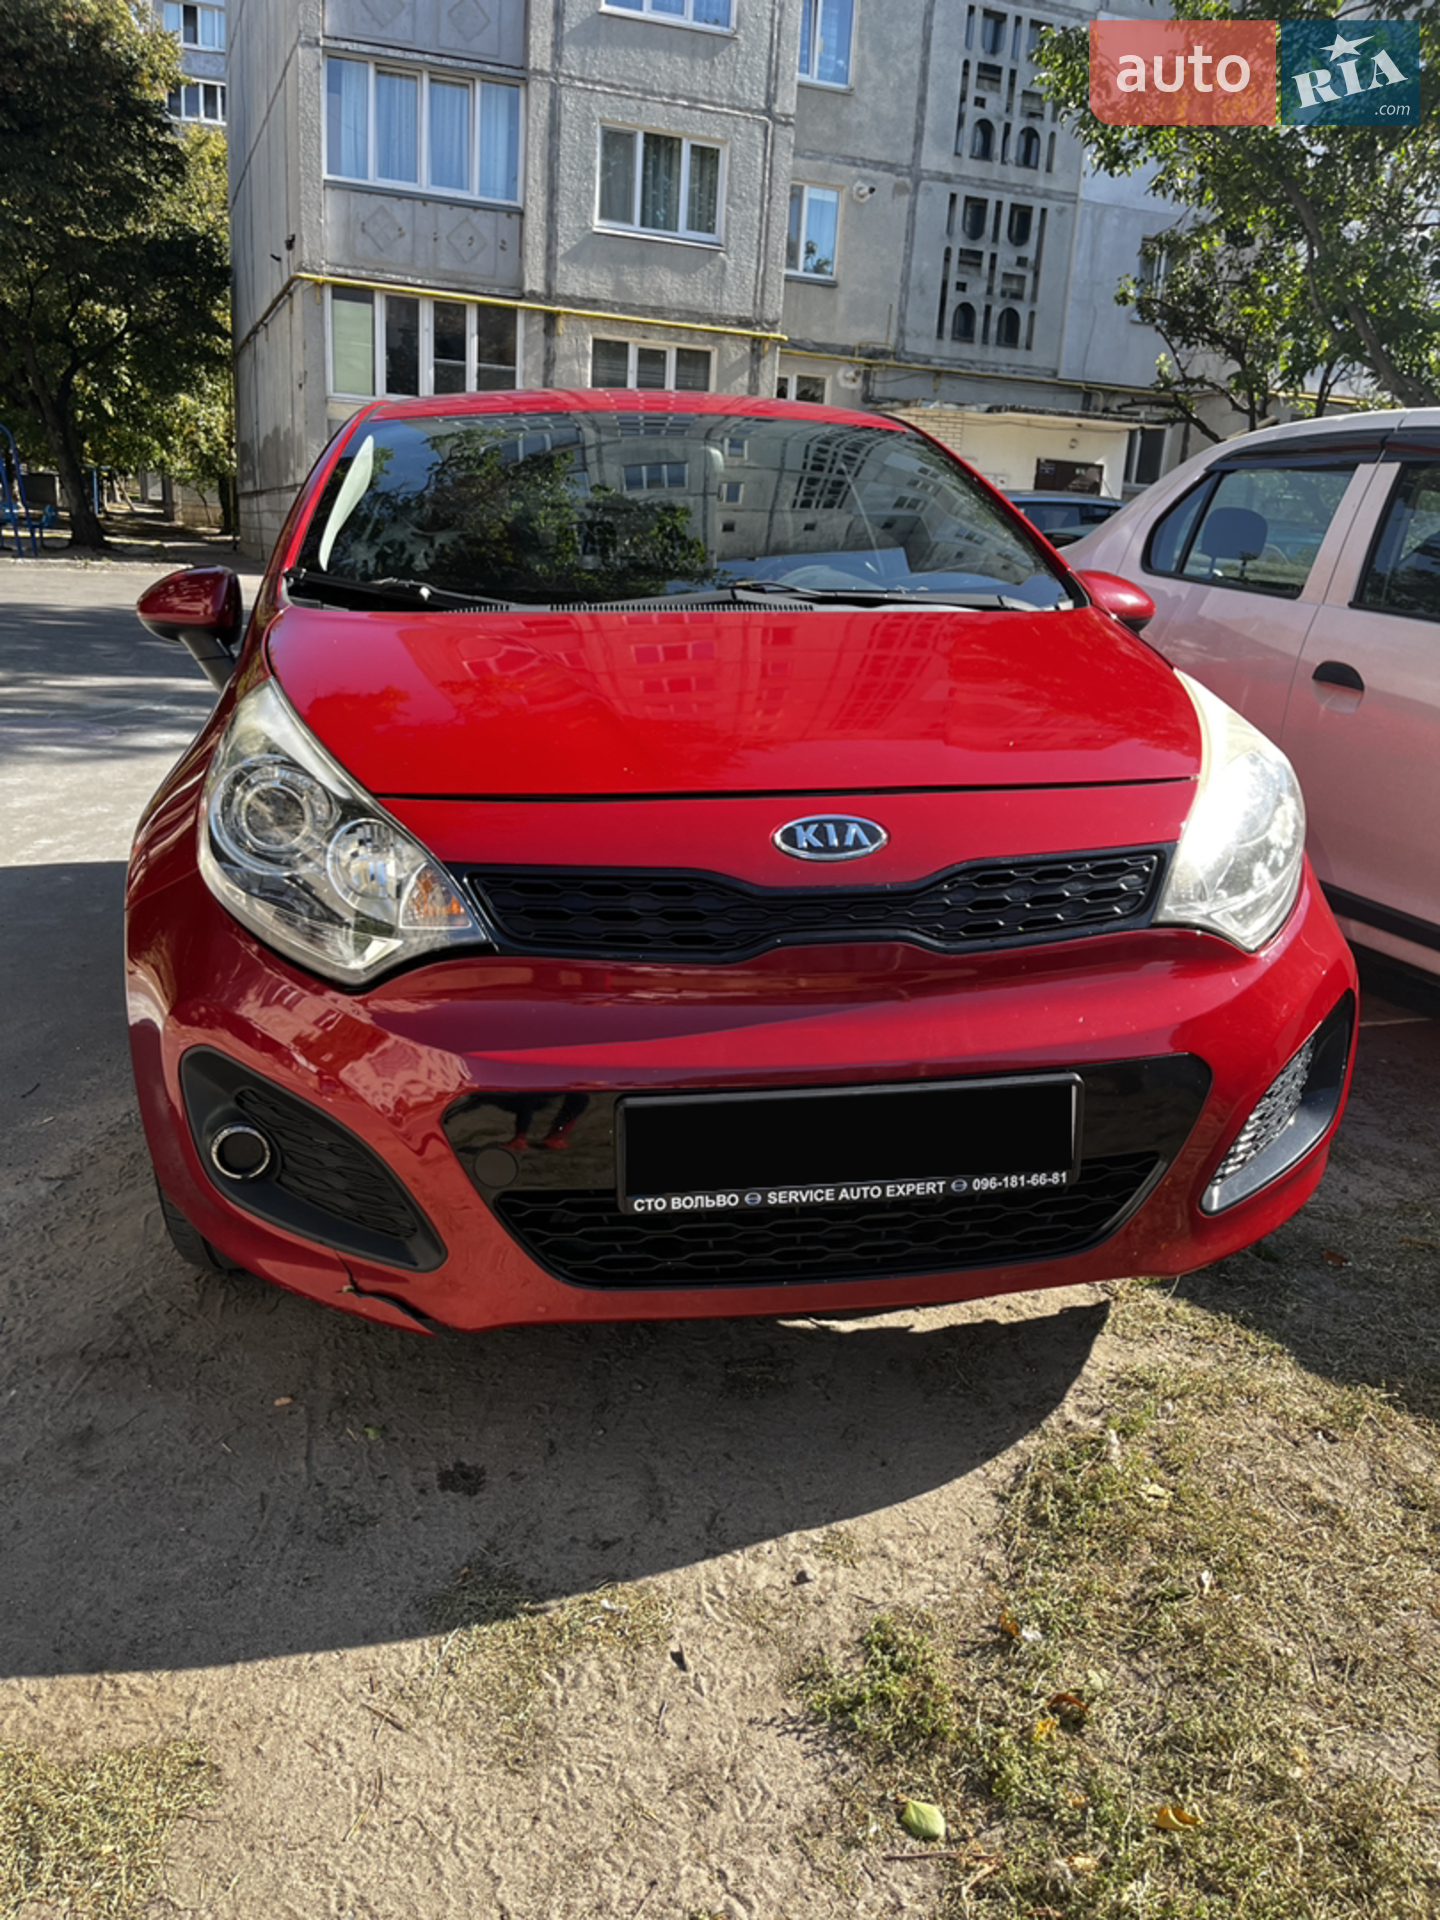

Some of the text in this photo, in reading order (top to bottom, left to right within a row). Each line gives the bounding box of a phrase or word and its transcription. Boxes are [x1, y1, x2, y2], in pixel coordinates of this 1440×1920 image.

[794, 822, 872, 849] KIA
[633, 1171, 1067, 1212] СТО ВОЛЬВО SERVICE AUTO EXPERT 096-181-66-81
